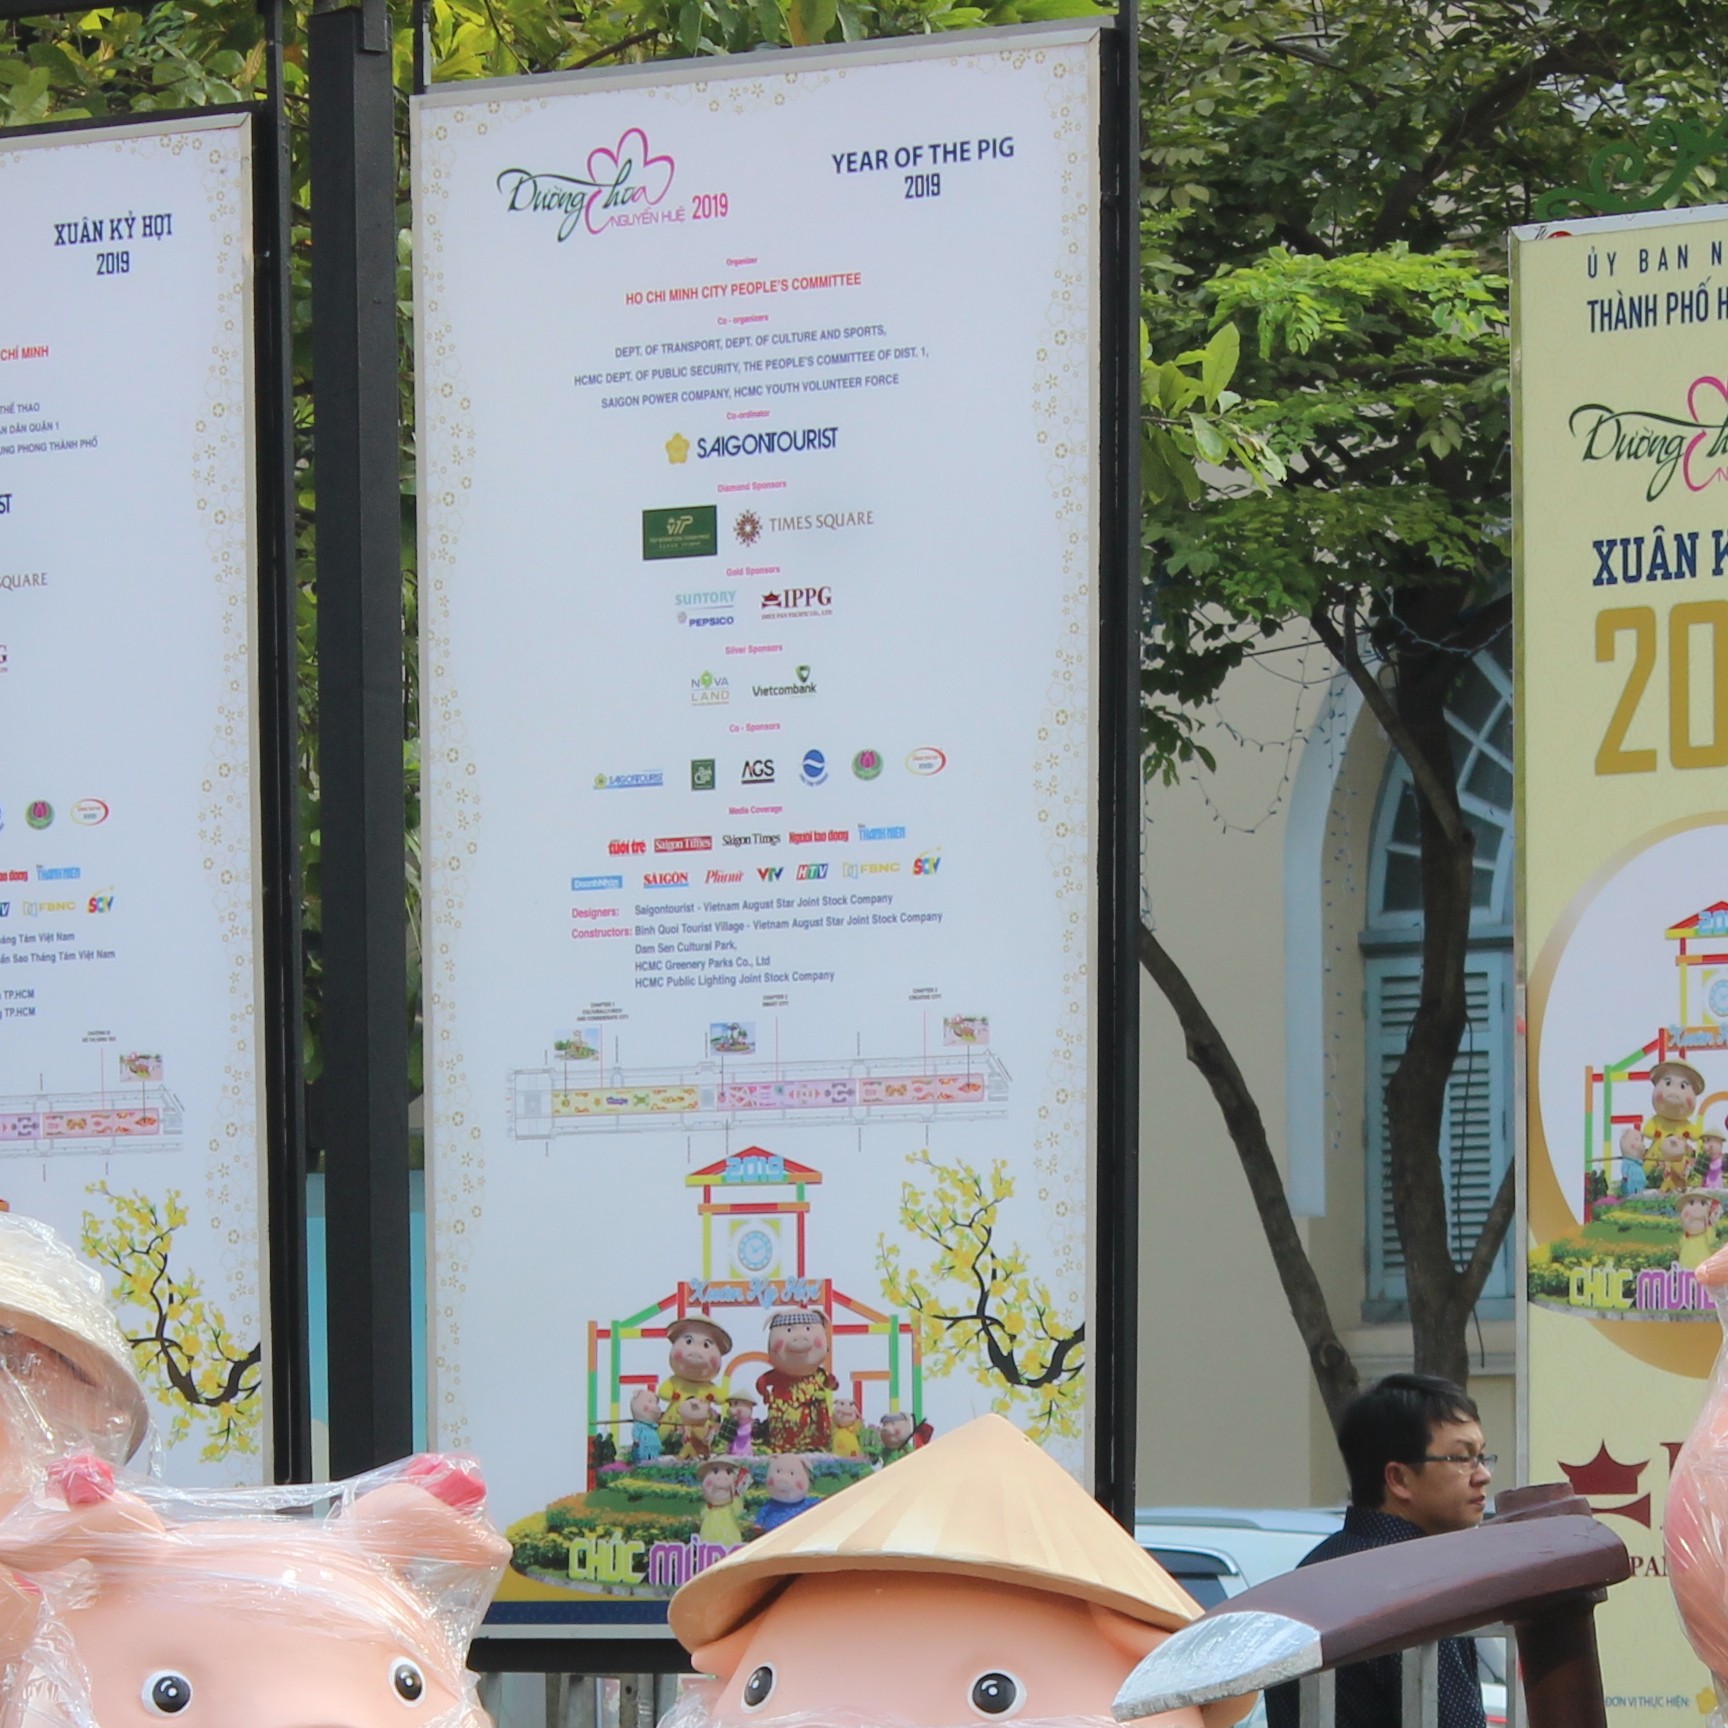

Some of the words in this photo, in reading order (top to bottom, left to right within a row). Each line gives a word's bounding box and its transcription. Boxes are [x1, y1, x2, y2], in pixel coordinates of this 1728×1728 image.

[832, 149, 888, 174] YEAR
[894, 146, 923, 168] OF
[929, 141, 971, 165] THE
[977, 136, 1015, 160] PIG
[904, 173, 940, 199] 2019
[692, 193, 728, 219] 2019
[54, 216, 104, 246] XUÂN
[96, 250, 130, 276] 2019
[1587, 246, 1617, 278] ỦY
[1639, 245, 1689, 273] BAN
[626, 292, 643, 304] HO
[646, 290, 665, 303] CHI
[669, 288, 698, 301] MINH
[702, 285, 727, 298] CITY
[731, 279, 788, 295] PEOPLE'S
[792, 272, 861, 290] COMMITTEE
[1587, 290, 1658, 333] THÀNH
[1666, 276, 1712, 325] PHỐ
[0, 346, 19, 362] CHÍ
[21, 344, 49, 359] MINH
[615, 346, 642, 358] DEPT.
[645, 344, 658, 355] OF
[661, 339, 723, 353] TRANSPORT,
[726, 336, 752, 348] DEPT.
[756, 335, 768, 346] OF
[772, 331, 817, 344] CULTURE
[820, 329, 841, 340] AND
[574, 374, 602, 386] HCMC
[606, 371, 632, 383] DEPT.
[636, 370, 648, 381] OF
[652, 367, 687, 379] PUBLIC
[690, 363, 741, 376] SECURITY,
[744, 360, 762, 371] THE
[766, 356, 814, 370] PEOPLE'S
[817, 351, 875, 365] COMMITTEE
[878, 349, 891, 360] OF
[894, 347, 918, 359] DIST.
[602, 396, 639, 408] SAIGON
[642, 392, 678, 405] POWER
[681, 388, 732, 402] COMPANY,
[734, 385, 762, 397] HCMC
[766, 382, 799, 394] YOUTH
[803, 377, 862, 391] VOLUNTEER
[865, 374, 898, 386] FORCE
[696, 427, 839, 458] SAIGONTOURIST
[770, 515, 812, 531] TIMES
[816, 511, 873, 530] SQUARE
[1592, 525, 1699, 586] XUÂN
[726, 568, 743, 576] Gold
[746, 567, 780, 576] Sponsors
[784, 586, 832, 608] IPPG
[689, 616, 734, 626] PEPSICO
[752, 679, 816, 696] Vietcombank
[572, 908, 619, 920] Designers:
[635, 903, 694, 917] Saigontourist
[704, 902, 739, 911] Vietnam
[743, 900, 773, 912] August
[777, 898, 794, 908] Star
[798, 897, 819, 907] Joint
[822, 896, 847, 906] Stock
[850, 894, 892, 906] Company
[572, 928, 632, 939] Constructors:
[1569, 1260, 1633, 1309] CHÚC
[569, 1532, 645, 1584] CHÚC
